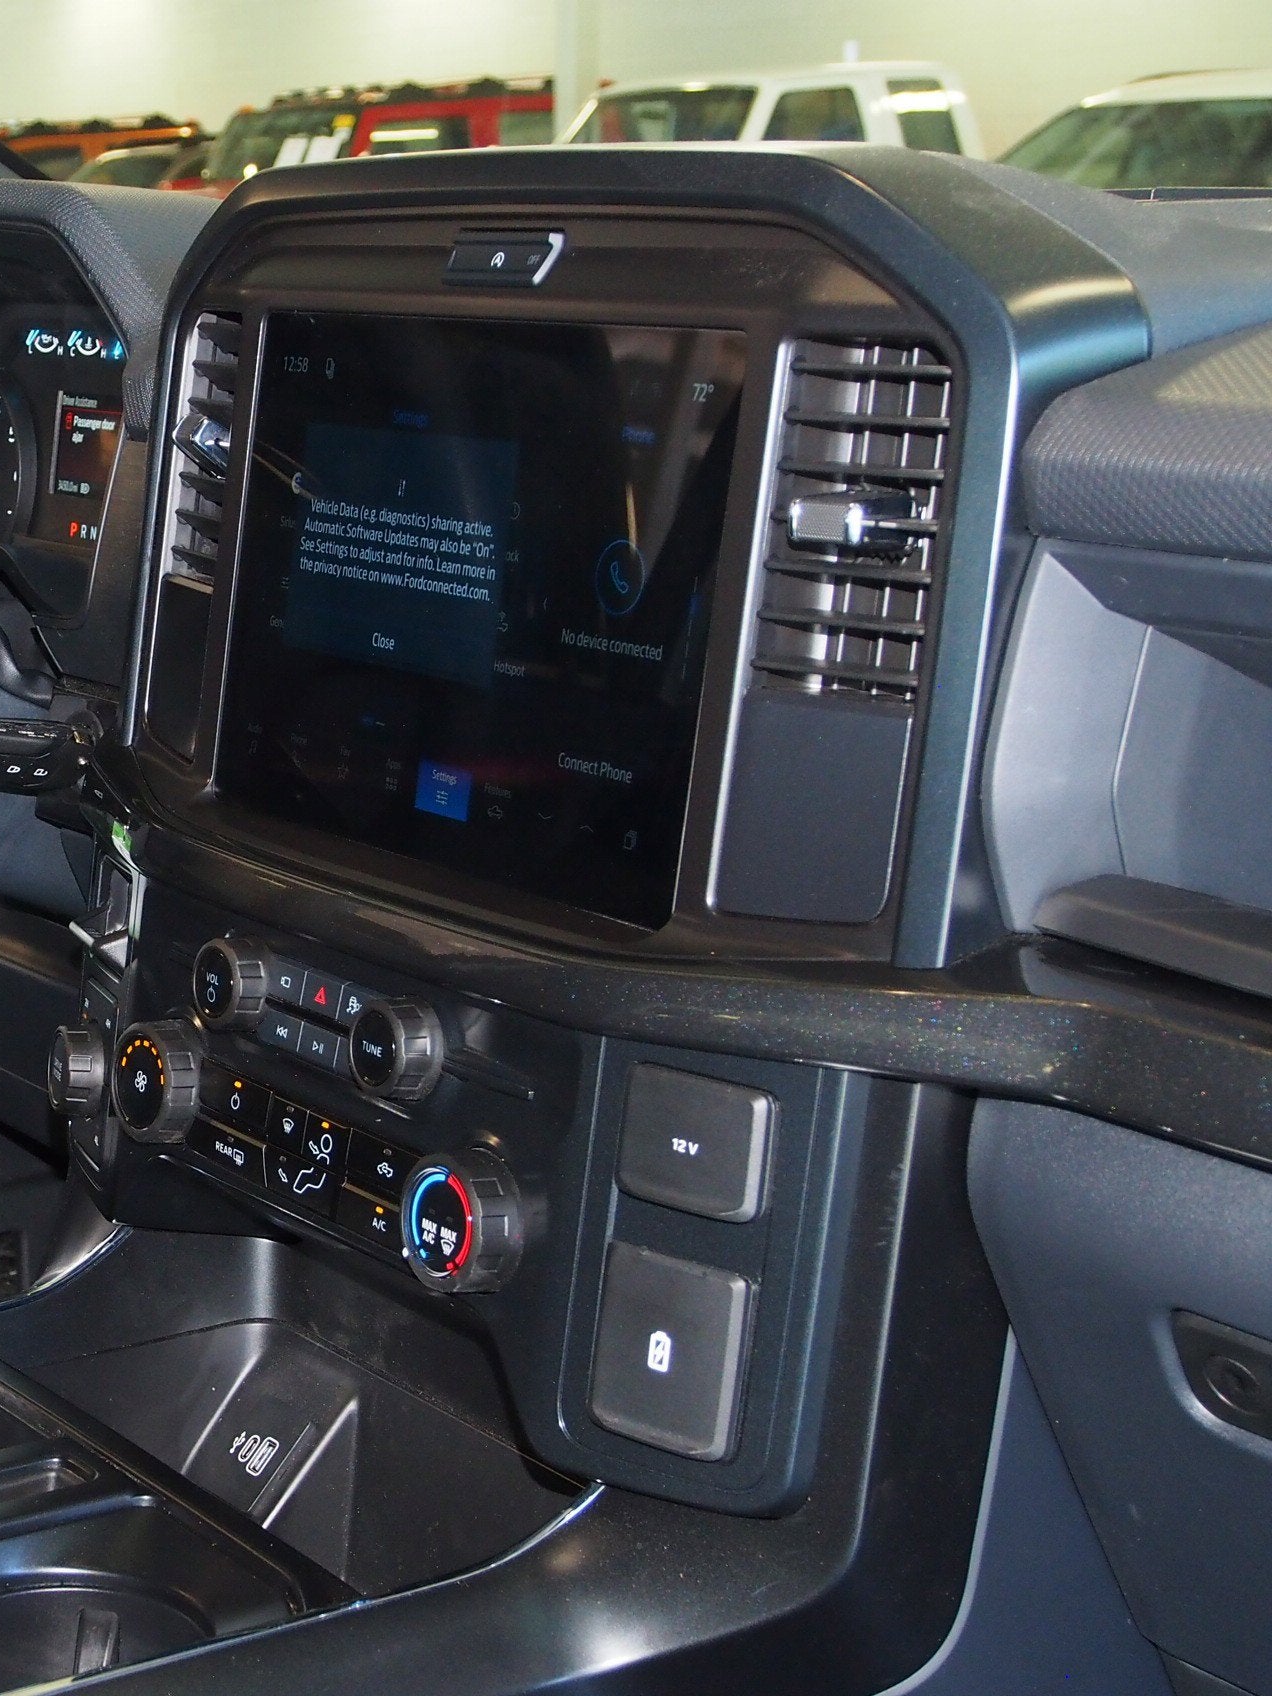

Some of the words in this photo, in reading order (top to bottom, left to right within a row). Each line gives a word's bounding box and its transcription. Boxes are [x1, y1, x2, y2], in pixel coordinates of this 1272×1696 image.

[527, 254, 541, 265] OFF
[283, 355, 309, 373] 12:58
[311, 499, 339, 515] Vehicle
[339, 502, 359, 518] Data
[360, 505, 378, 522] (e.g.
[379, 508, 431, 531] diagnostics)
[431, 517, 463, 537] sharing
[464, 521, 494, 538] active.
[70, 522, 78, 538] P
[80, 524, 88, 539] R
[90, 526, 98, 541] N
[304, 518, 346, 537] Automatic
[346, 524, 383, 542] Software
[384, 529, 419, 546] Updates
[420, 537, 439, 552] may
[439, 537, 459, 554] also
[459, 541, 471, 556] be
[300, 537, 315, 551] See
[315, 539, 349, 559] Settings
[350, 545, 359, 558] to
[359, 546, 385, 567] adjust
[386, 550, 402, 565] and
[403, 552, 417, 568] for
[417, 554, 436, 571] info.
[436, 558, 462, 575] Learn
[462, 564, 486, 579] more
[487, 565, 496, 581] in
[300, 556, 313, 572] the
[314, 559, 341, 579] privacy
[342, 564, 368, 581] notice
[368, 569, 380, 582] on
[371, 632, 395, 650] Close
[561, 627, 576, 645] No
[577, 630, 608, 649] device
[609, 636, 664, 661] connected
[493, 657, 526, 677] Hotspot
[432, 769, 458, 786] Settings
[558, 752, 599, 777] Connect
[599, 761, 633, 785] Phone
[205, 971, 219, 985] VOL
[362, 1040, 383, 1058] TUNE
[215, 1140, 233, 1158] REAR
[372, 1217, 387, 1232] A/C
[421, 1217, 438, 1235] MAX
[422, 1230, 435, 1245] A/C
[440, 1226, 457, 1243] MAX
